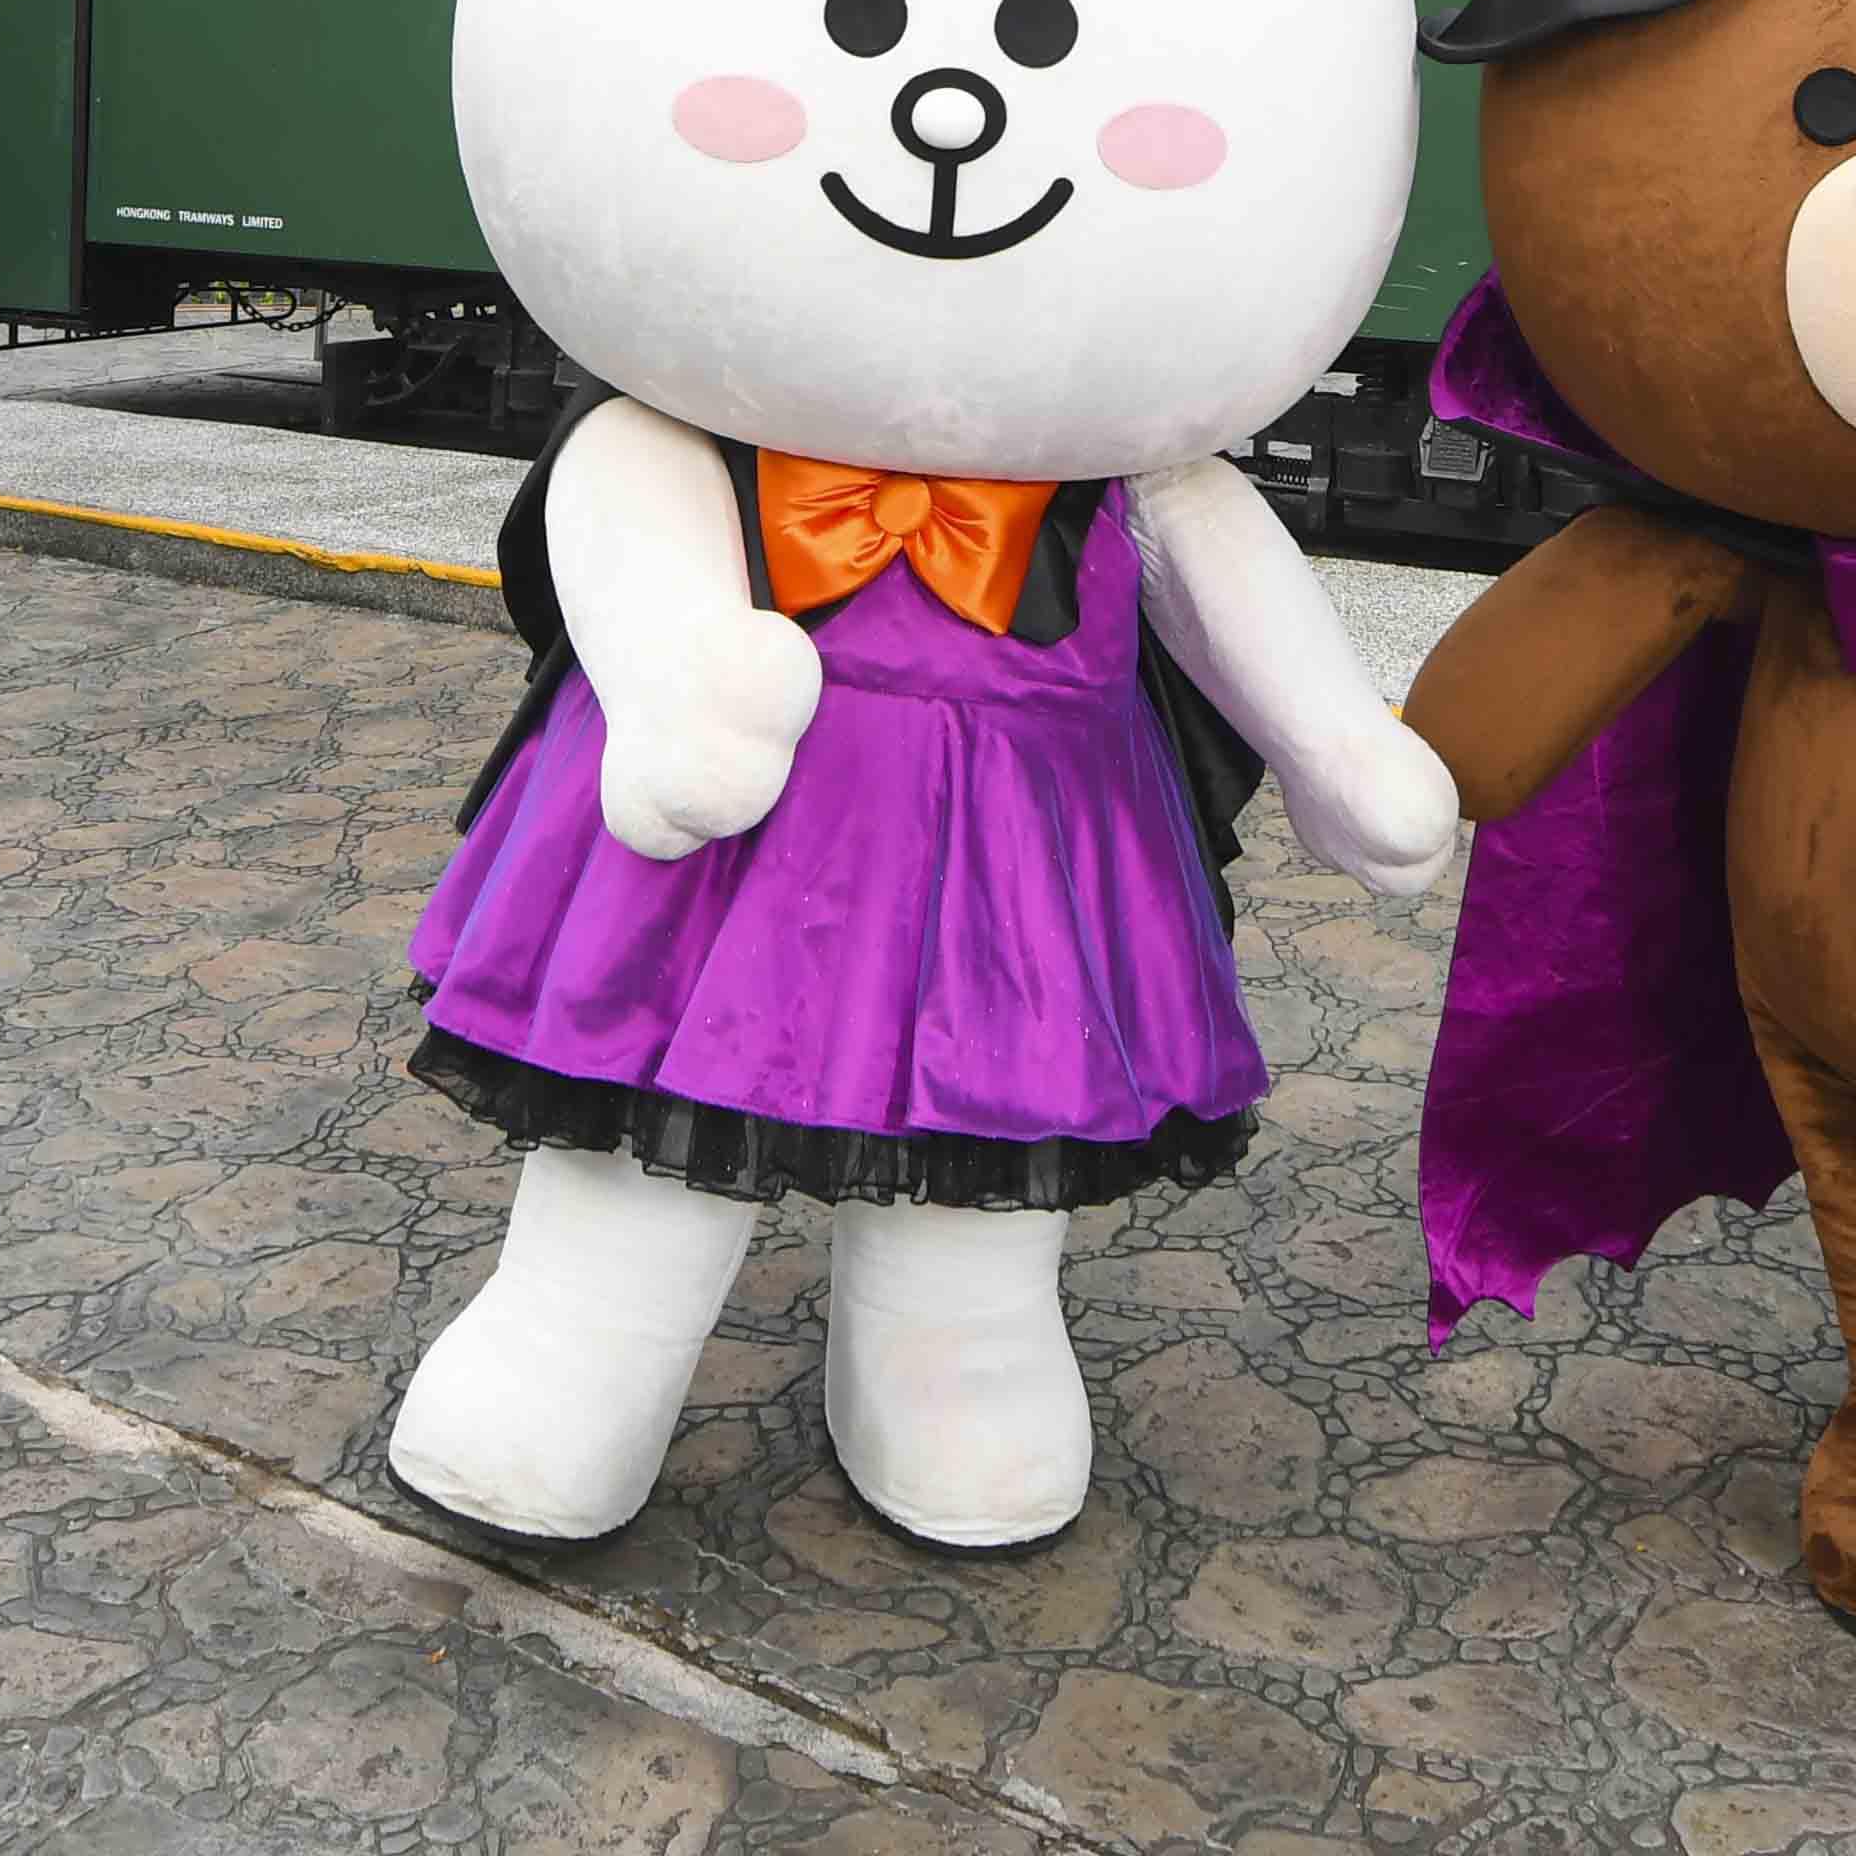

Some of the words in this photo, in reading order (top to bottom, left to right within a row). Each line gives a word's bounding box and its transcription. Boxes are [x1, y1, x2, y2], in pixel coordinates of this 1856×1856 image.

[116, 206, 172, 222] HONGKONG
[178, 210, 235, 227] TRAMWAYS
[241, 215, 284, 230] LIMITED
